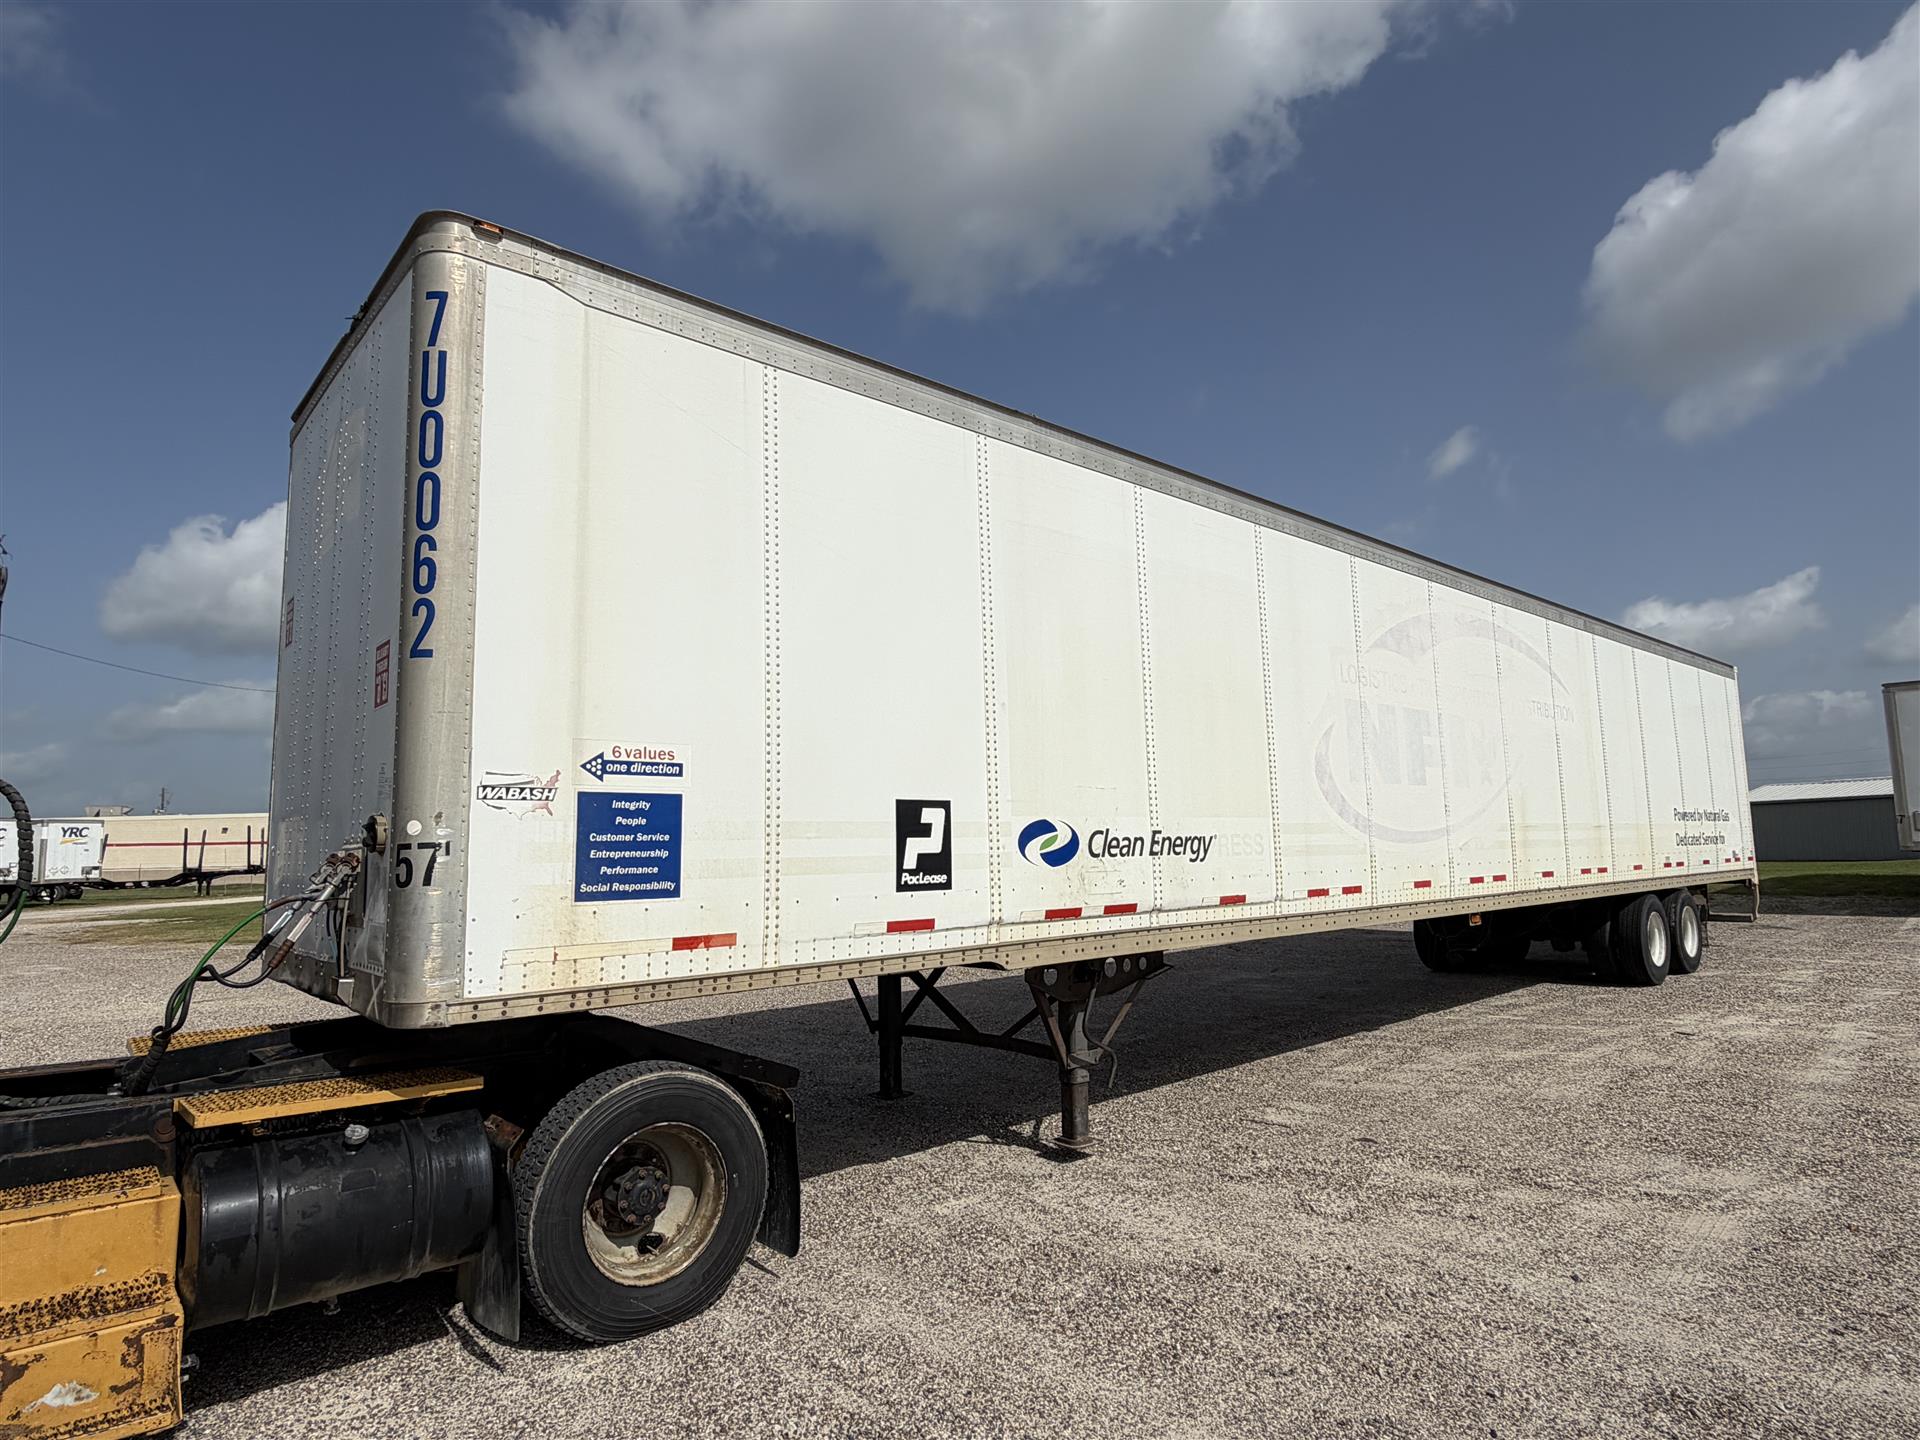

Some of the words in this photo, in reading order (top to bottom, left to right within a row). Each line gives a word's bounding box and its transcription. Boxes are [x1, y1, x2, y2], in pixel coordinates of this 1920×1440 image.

[409, 291, 449, 659] 7U0062
[612, 745, 622, 759] 6
[624, 746, 675, 760] values
[606, 763, 628, 772] one
[630, 762, 680, 774] direction
[478, 786, 556, 800] WABASH
[612, 799, 652, 811] Integrity
[615, 817, 647, 827] People
[1673, 808, 1696, 822] Powered
[1697, 808, 1704, 825] by
[1703, 809, 1721, 822] Natural
[1721, 809, 1730, 822] Gas
[60, 827, 90, 838] YRC
[590, 832, 634, 842] Customer
[636, 832, 671, 842] Service
[1675, 832, 1702, 847] Dedicated
[1702, 831, 1719, 846] Service
[1088, 828, 1145, 859] Clean
[590, 848, 670, 860] Entrepreneurship
[600, 865, 659, 875] Performance
[901, 871, 948, 885] PacLease
[580, 883, 609, 893] Social
[611, 880, 676, 893] Responsibility
